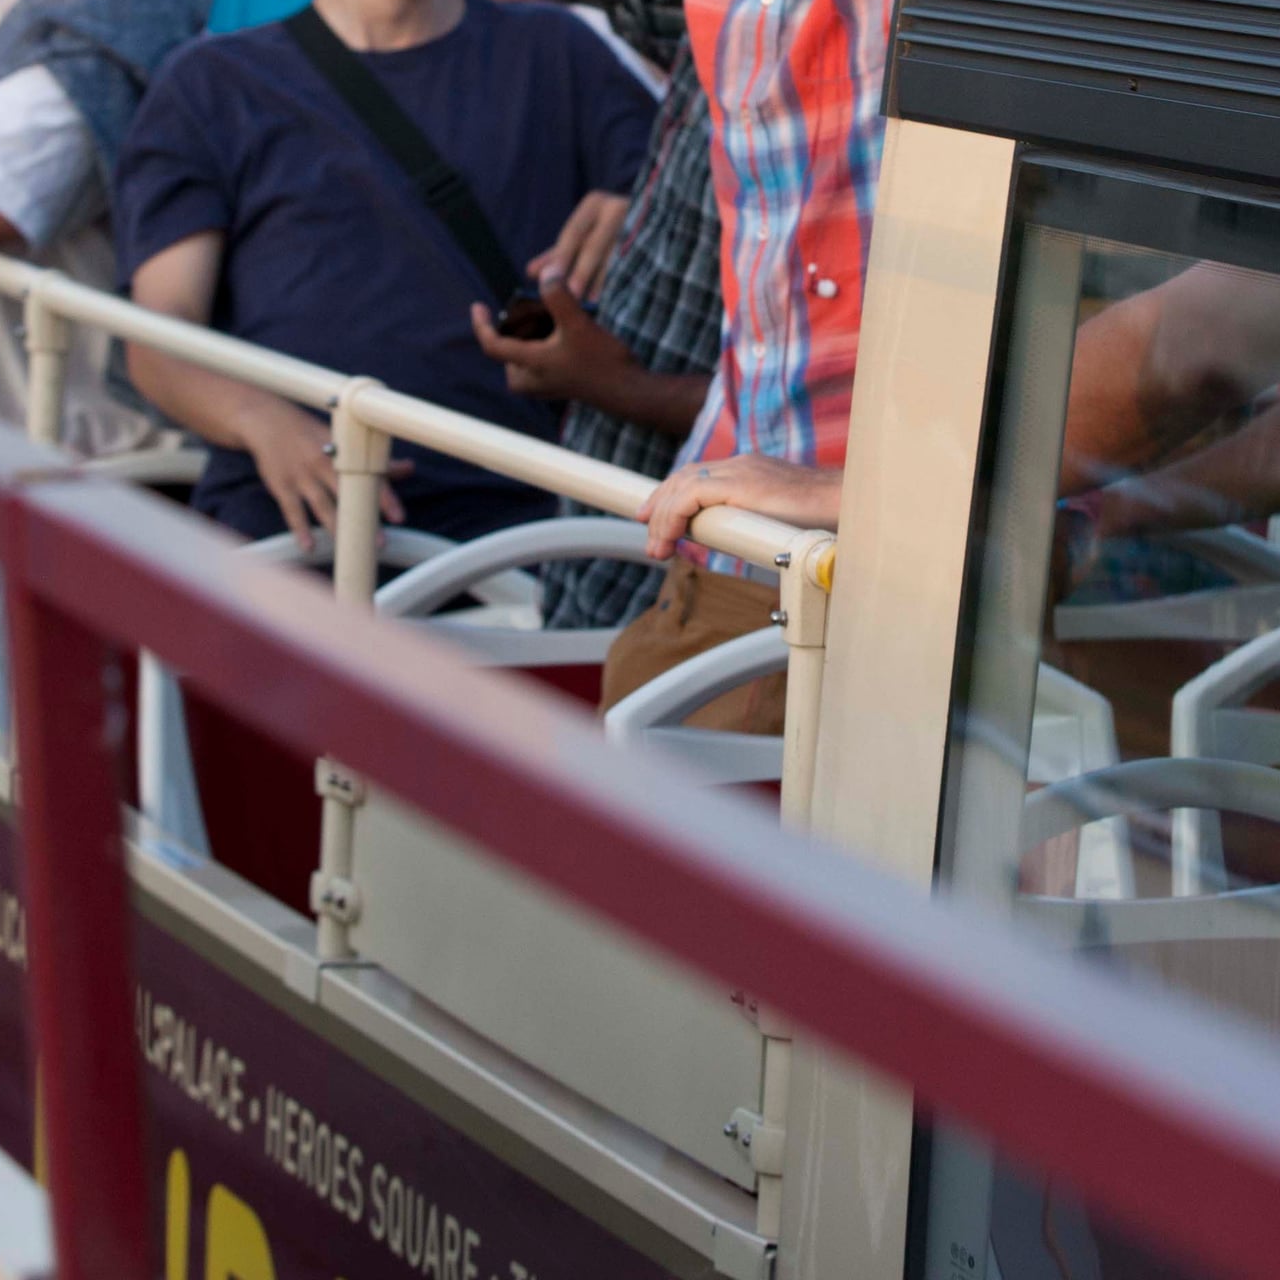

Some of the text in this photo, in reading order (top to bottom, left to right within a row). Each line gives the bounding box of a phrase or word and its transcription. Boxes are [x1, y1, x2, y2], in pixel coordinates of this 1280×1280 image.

[153, 1002, 246, 1133] PALACE
[266, 1084, 363, 1223] HEROES
[370, 1164, 481, 1280] SQUARE
